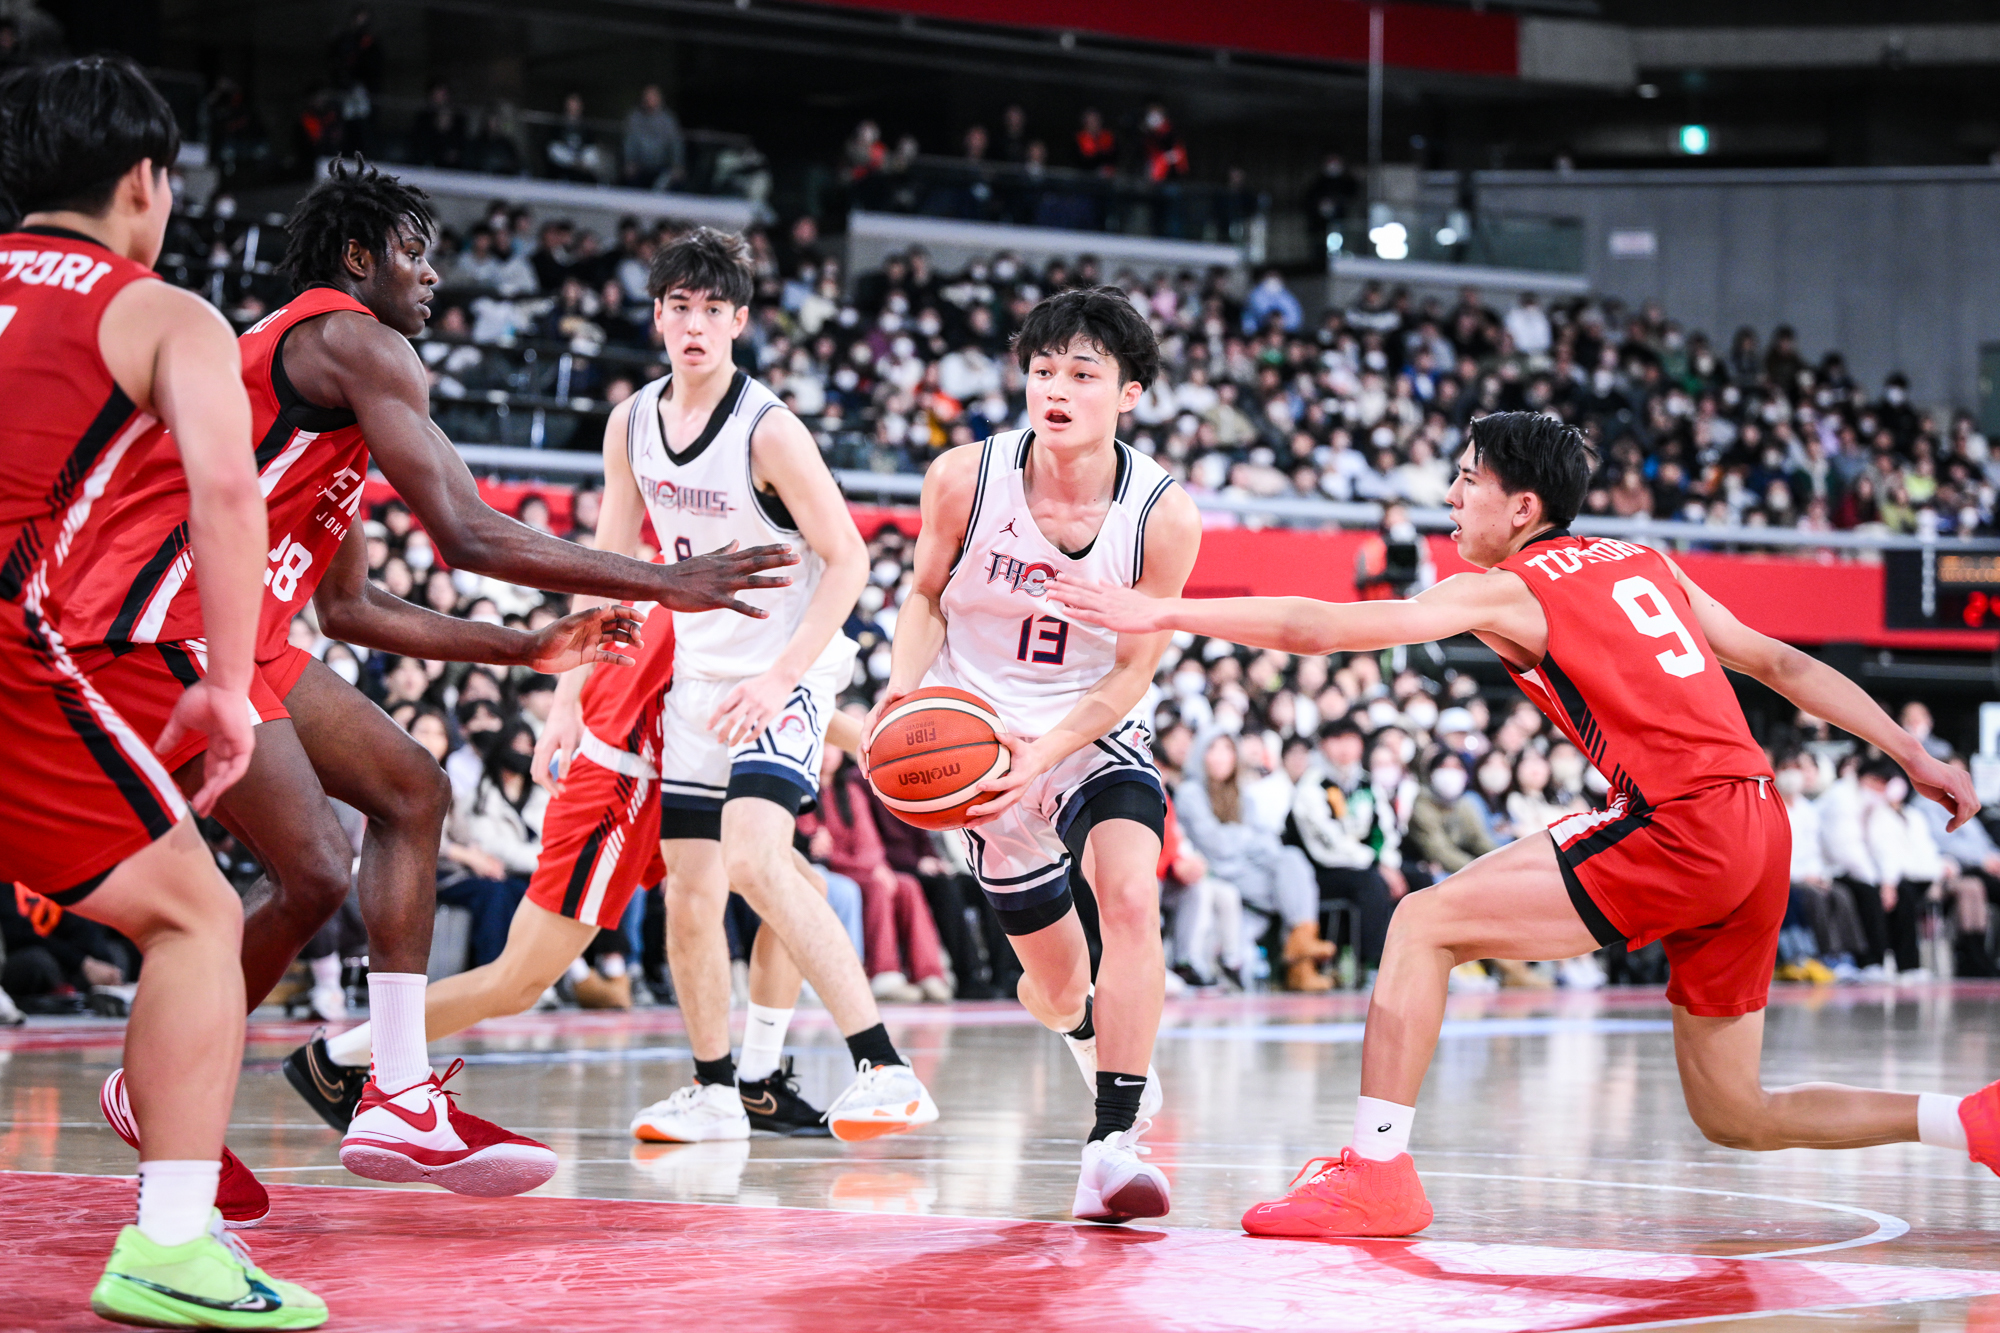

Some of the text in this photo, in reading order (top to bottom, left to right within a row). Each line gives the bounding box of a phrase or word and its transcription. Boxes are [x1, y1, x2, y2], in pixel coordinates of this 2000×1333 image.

[1016, 613, 1070, 666] 13
[1611, 575, 1706, 678] 9
[906, 727, 937, 745] FIBA
[898, 762, 961, 786] molten
